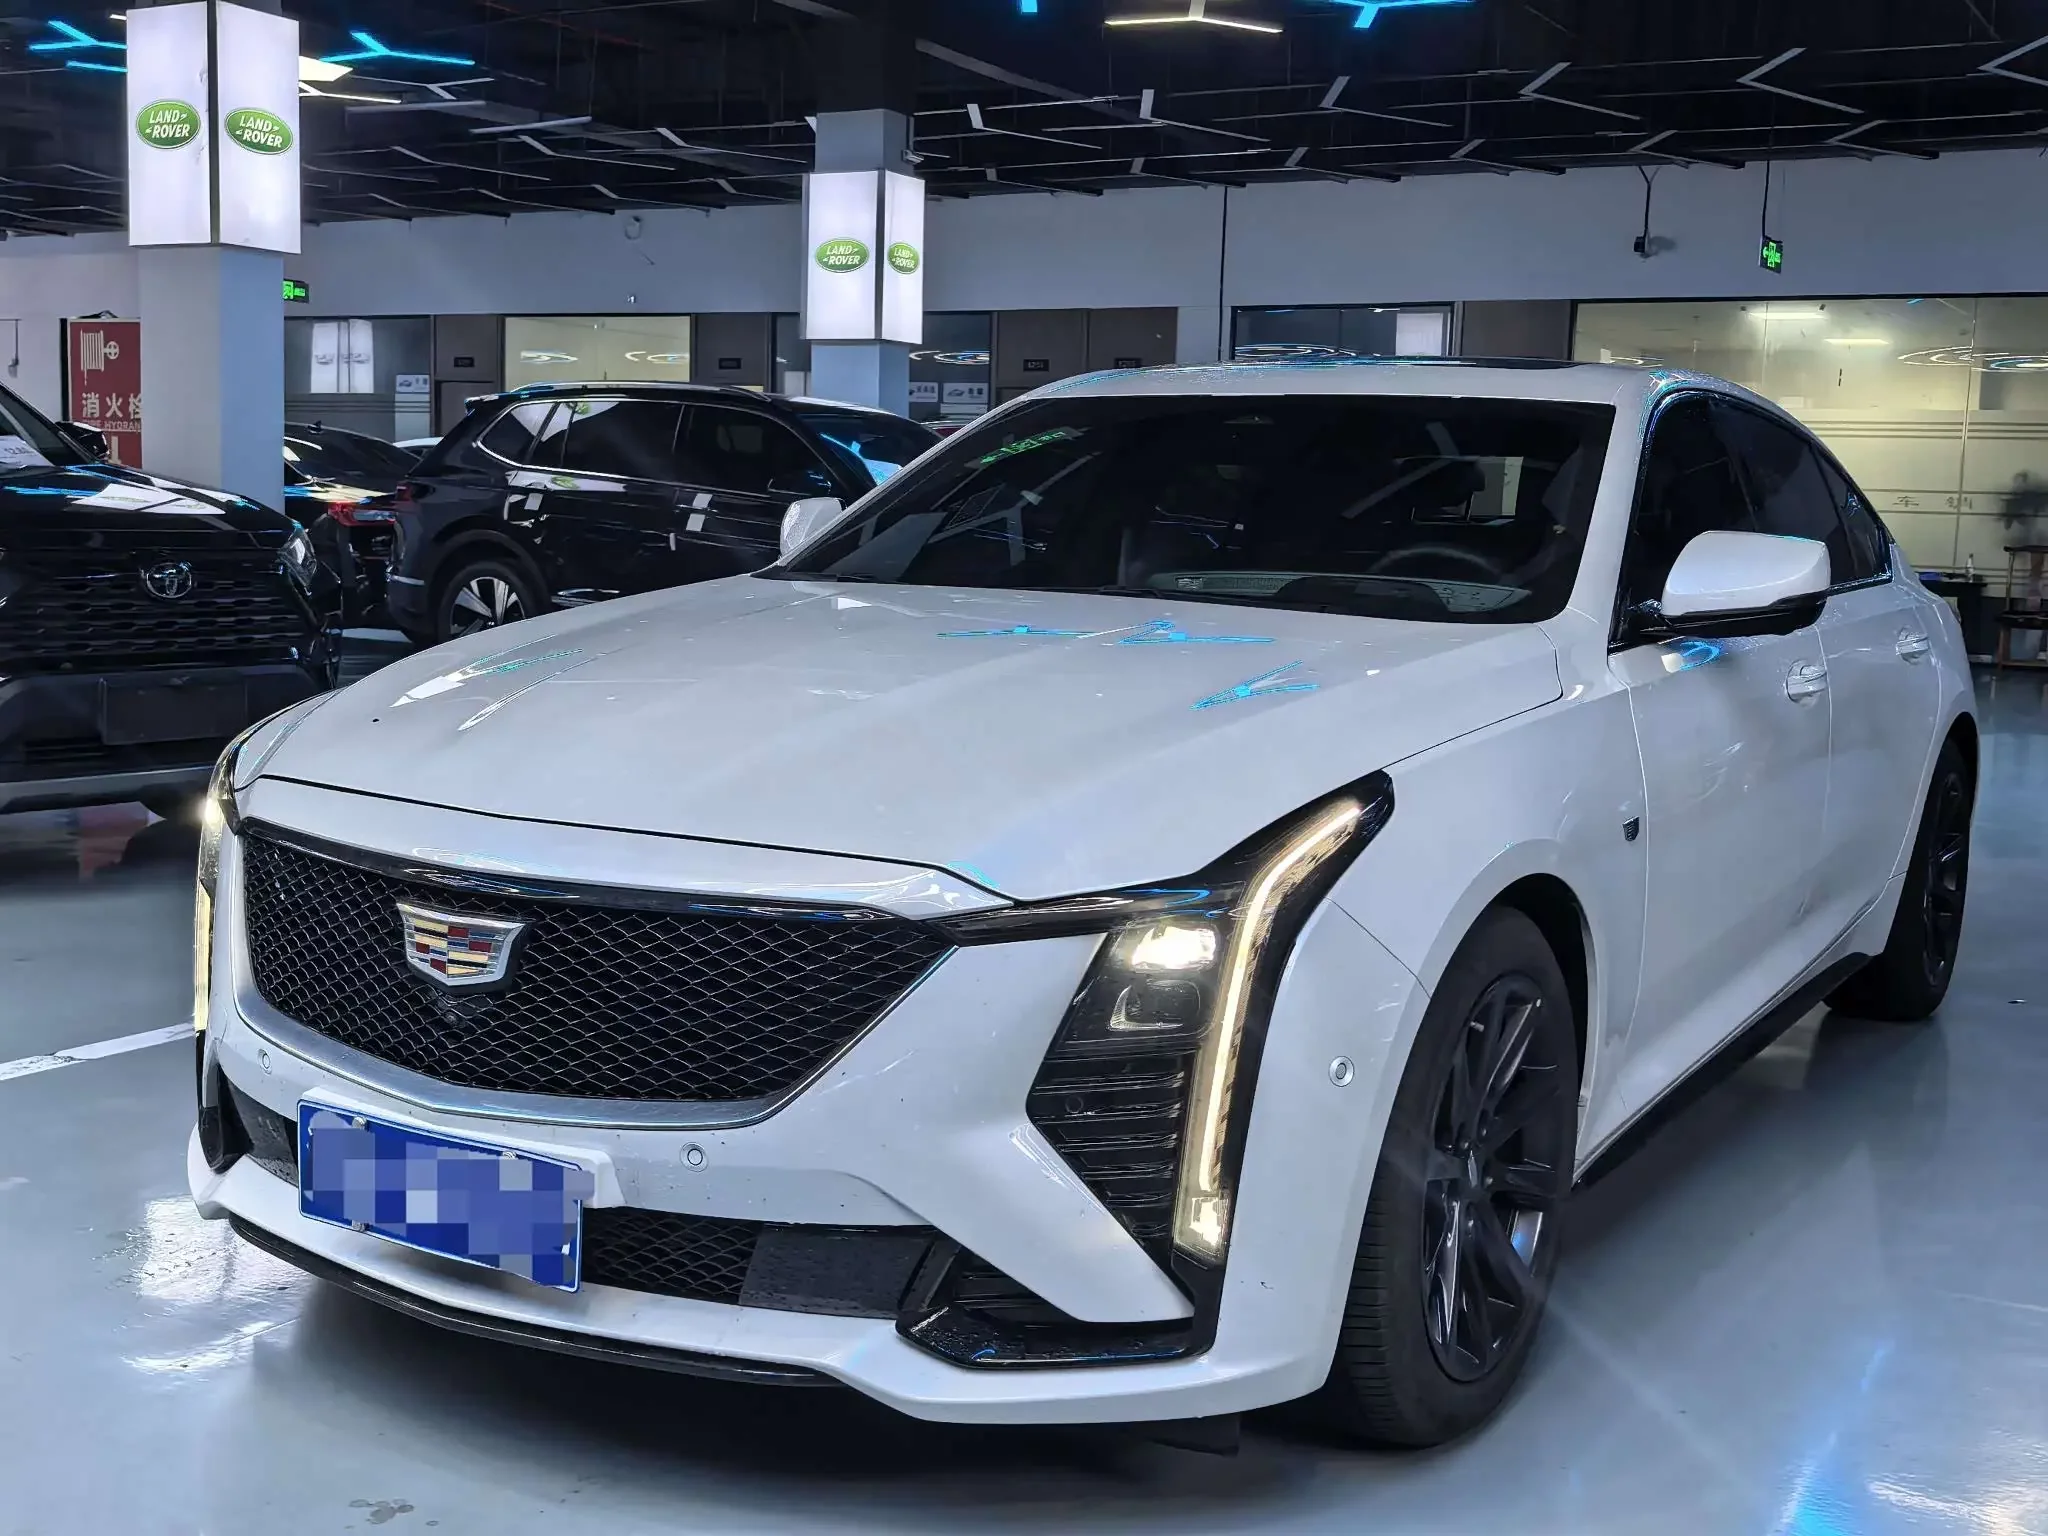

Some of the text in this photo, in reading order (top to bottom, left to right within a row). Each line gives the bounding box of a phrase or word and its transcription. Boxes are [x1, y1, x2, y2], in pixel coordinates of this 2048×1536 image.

[149, 110, 182, 124] LAND
[239, 115, 274, 132] LAND
[151, 124, 190, 139] ROVER
[242, 129, 283, 148] ROVER
[826, 245, 855, 256] LAND
[827, 255, 861, 266] ROVER
